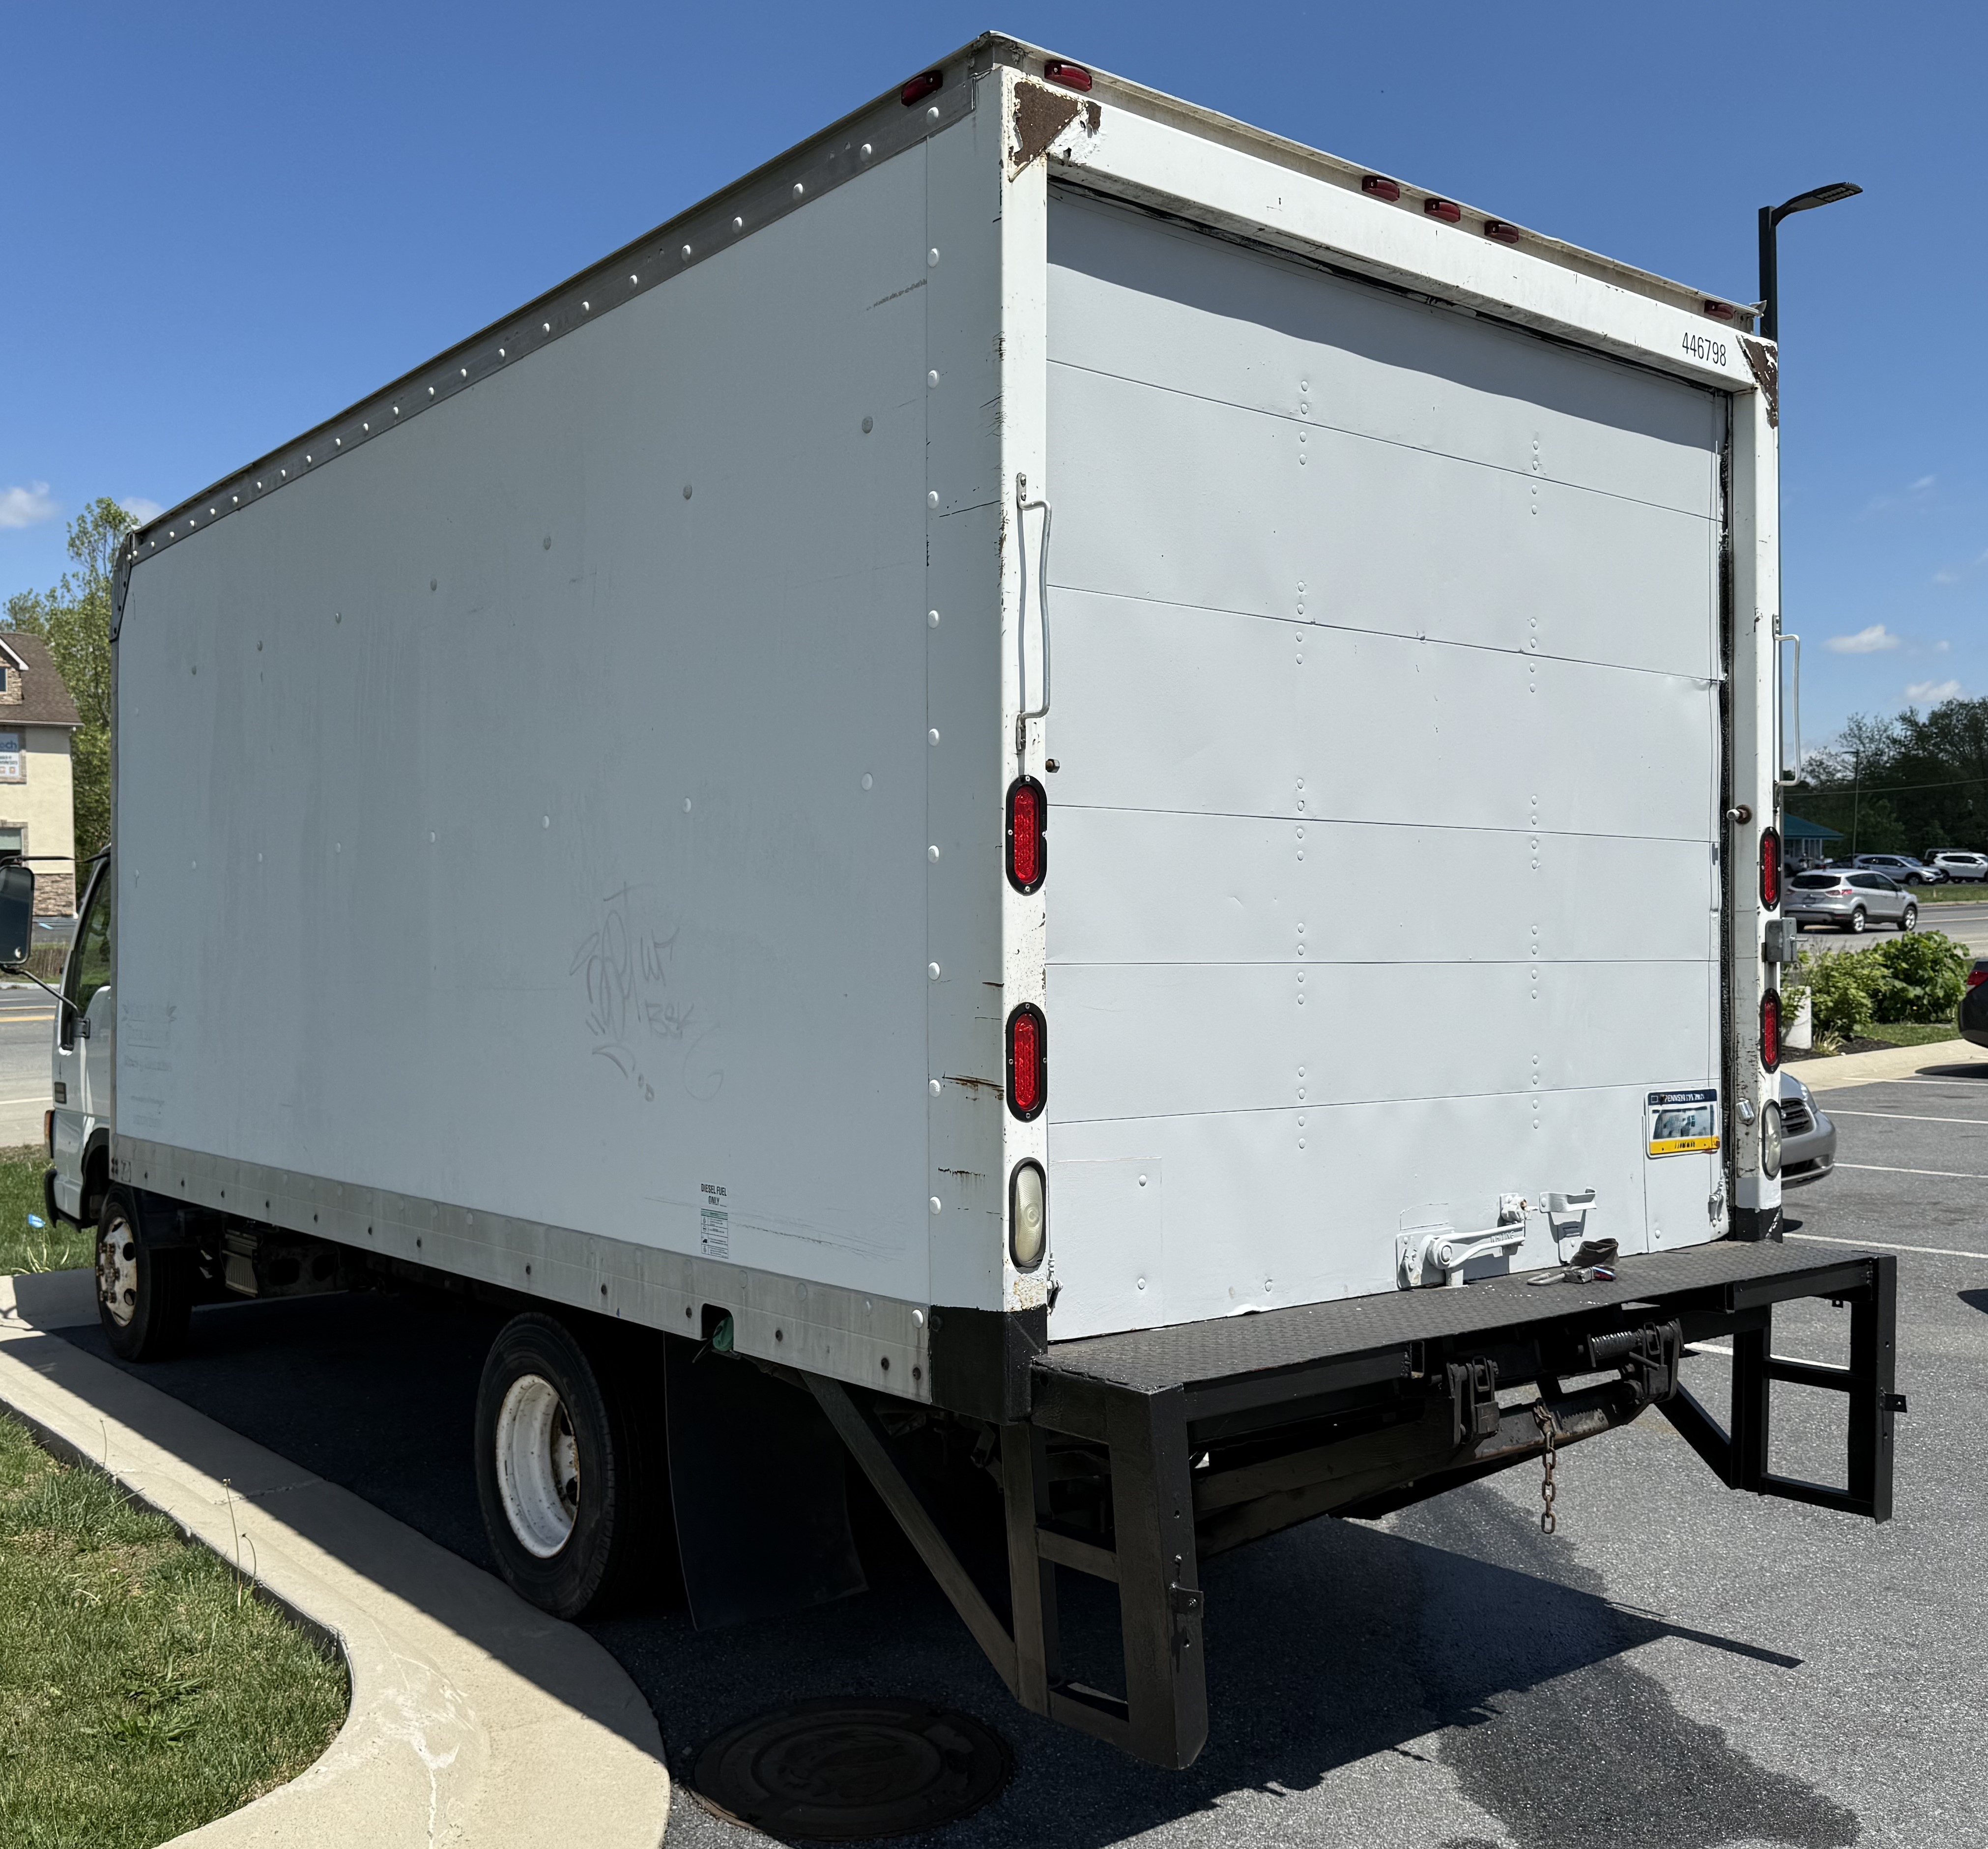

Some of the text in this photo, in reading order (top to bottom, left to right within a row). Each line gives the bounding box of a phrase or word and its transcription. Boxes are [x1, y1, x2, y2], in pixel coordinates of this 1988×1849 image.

[1682, 332, 1727, 367] 446798
[701, 1183, 727, 1196] DIESEL FUEL
[708, 1195, 720, 1205] ONLY
